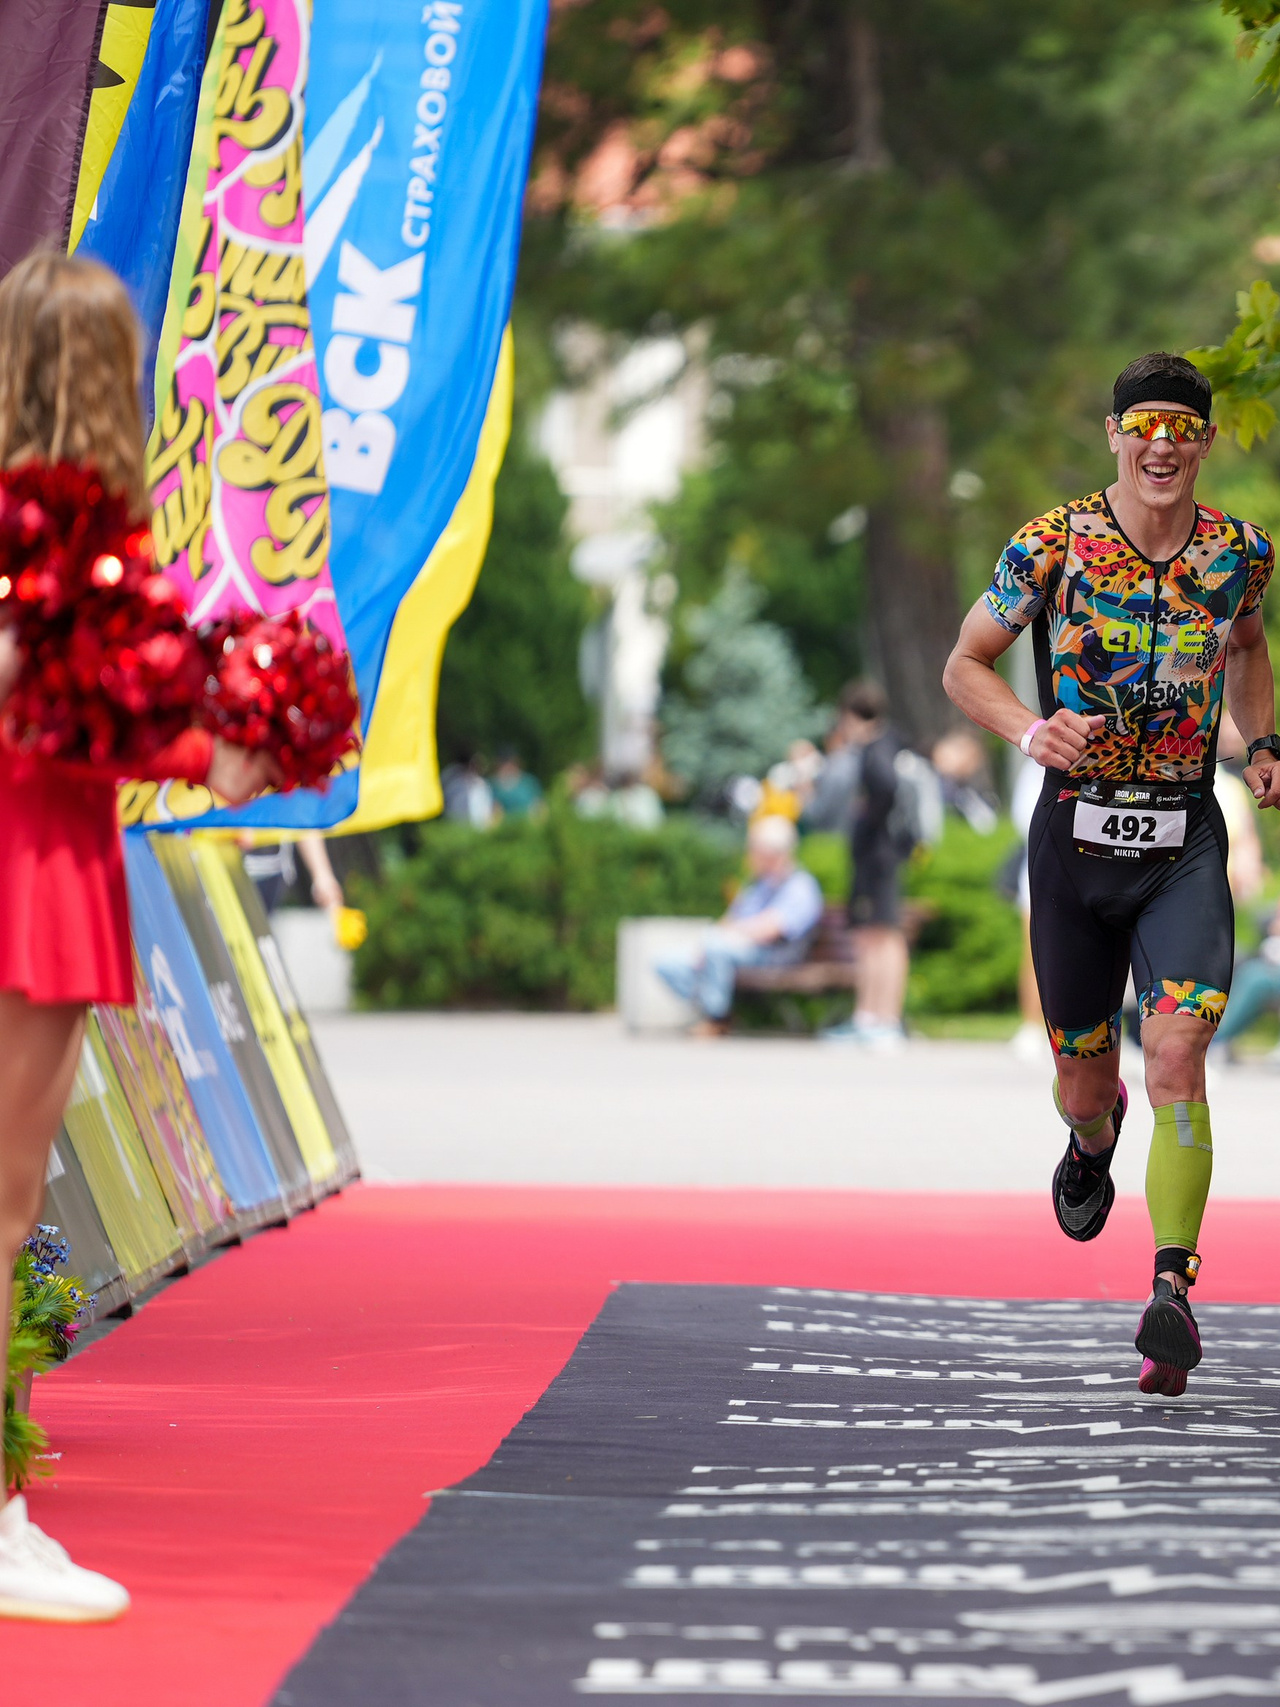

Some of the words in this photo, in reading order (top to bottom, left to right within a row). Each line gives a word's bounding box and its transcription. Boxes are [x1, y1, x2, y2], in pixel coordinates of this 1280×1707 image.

[321, 240, 425, 495] ВСК
[401, 0, 464, 248] СТРАХОВОЙ
[1115, 790, 1130, 798] IRON
[1135, 791, 1150, 800] STAR
[1101, 814, 1157, 843] 492
[1114, 848, 1140, 858] NIKITA
[751, 1363, 1022, 1381] IRON
